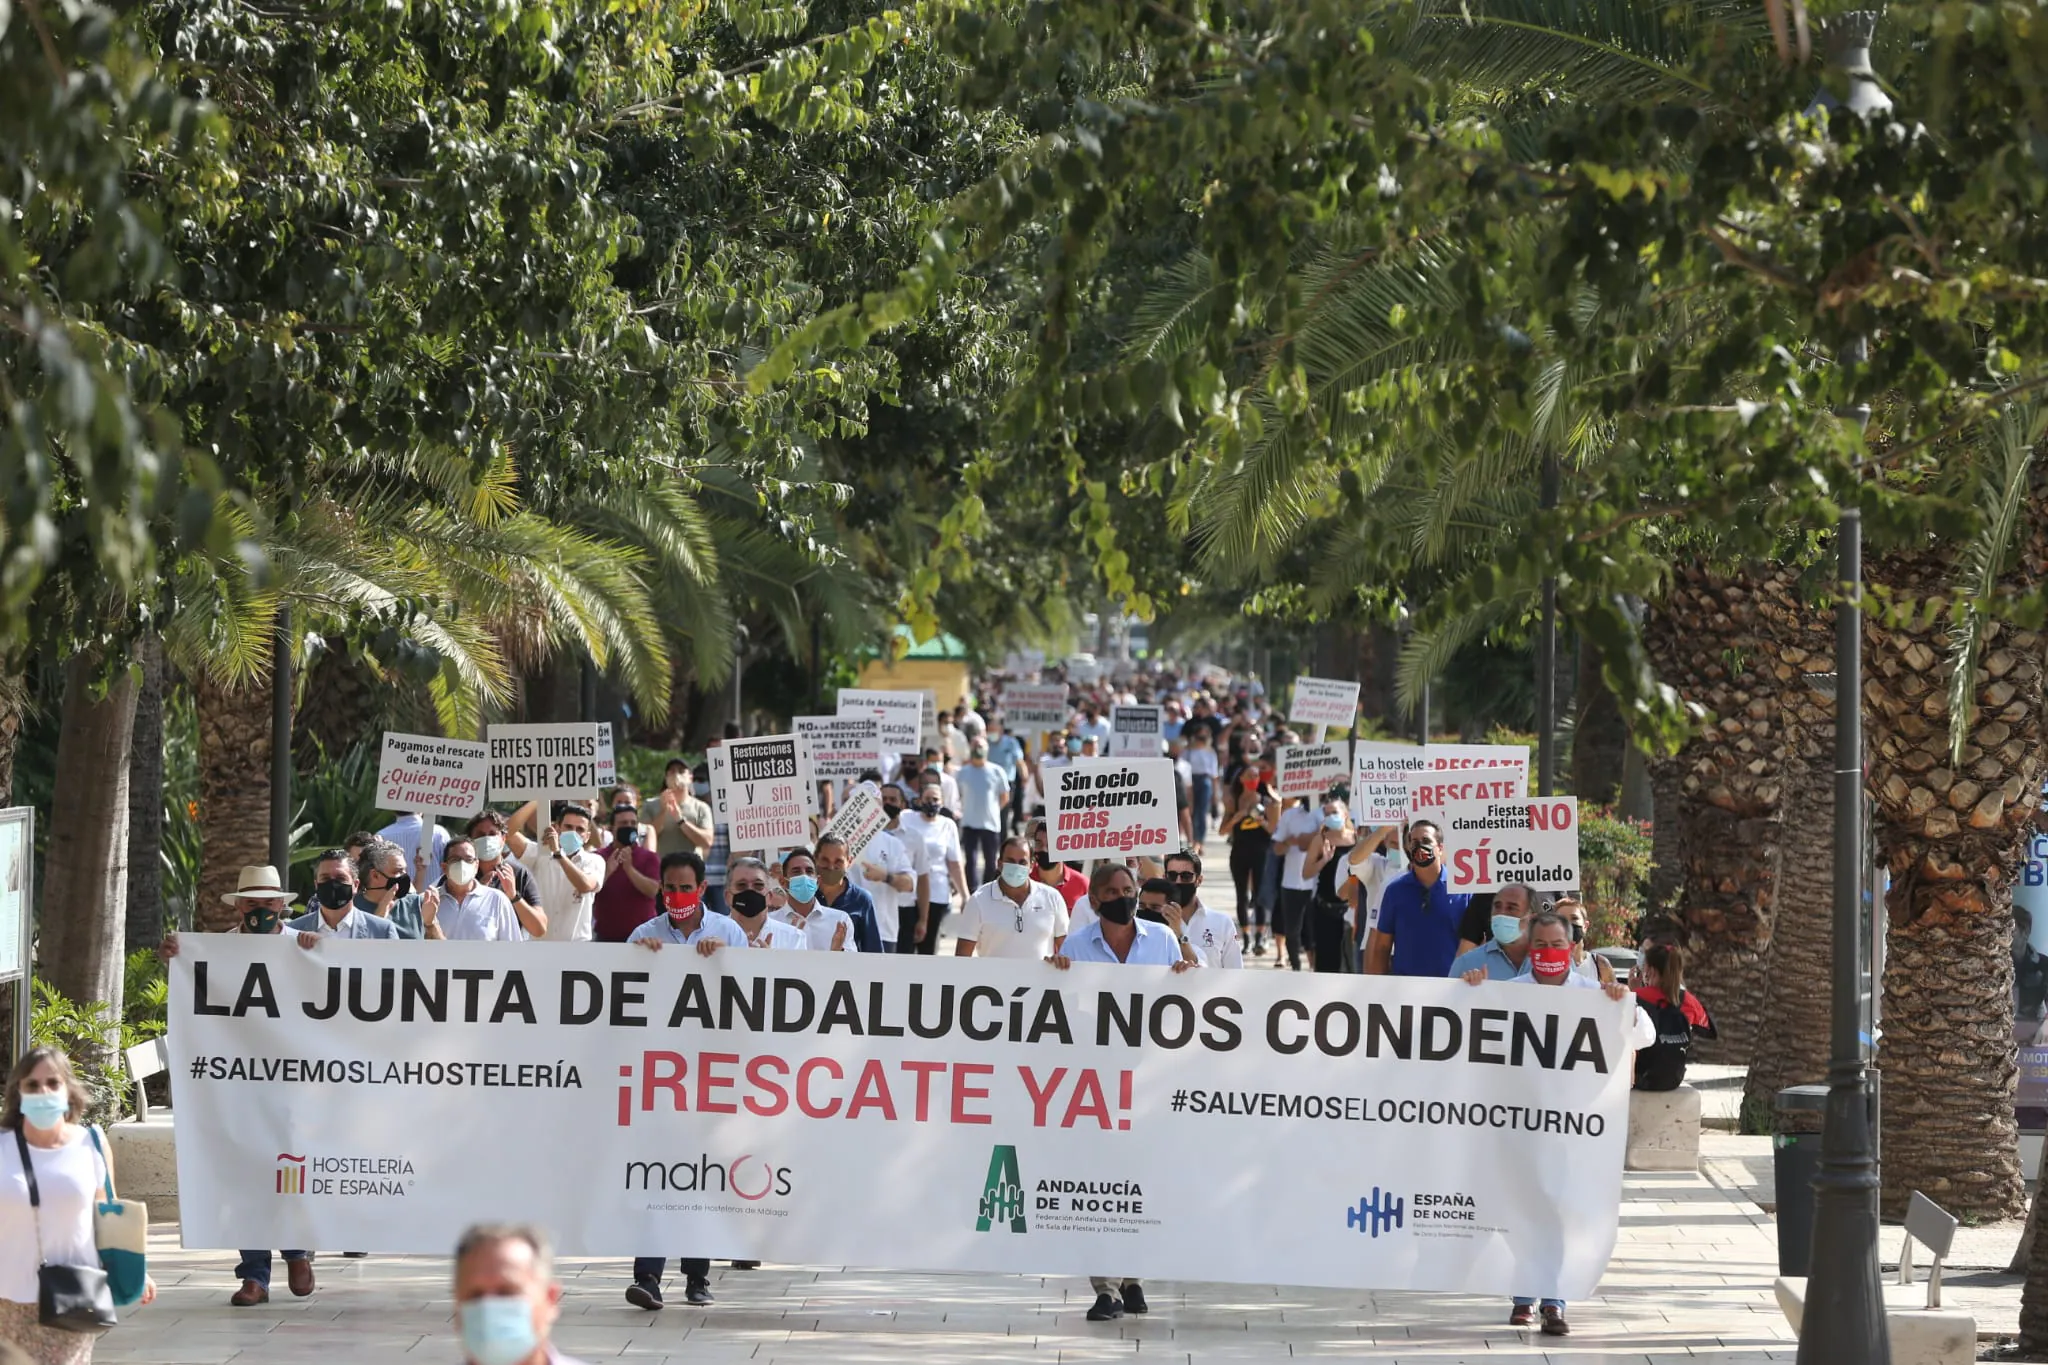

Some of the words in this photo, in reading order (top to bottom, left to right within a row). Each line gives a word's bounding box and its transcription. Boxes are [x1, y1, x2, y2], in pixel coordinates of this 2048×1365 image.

[842, 698, 864, 707] Junta
[866, 698, 875, 706] de
[798, 722, 813, 731] NO
[388, 738, 434, 753] Pagamos
[436, 742, 445, 755] el
[446, 745, 485, 759] rescate
[491, 737, 532, 759] ERTES
[536, 736, 594, 758] TOTALES
[733, 743, 792, 758] Restricciones
[832, 740, 861, 749] ERTE
[883, 736, 915, 746] ayudas
[406, 753, 418, 765] de
[421, 754, 430, 766] la
[432, 756, 463, 770] banca
[1286, 748, 1303, 760] Sin
[1305, 746, 1331, 757] ocio
[734, 758, 794, 780] injustas
[1284, 756, 1341, 770] nocturno,
[1360, 757, 1374, 770] La
[1378, 756, 1424, 770] hostele
[382, 767, 437, 786] ¿Quién
[440, 776, 481, 794] paga
[491, 763, 548, 789] HASTA
[554, 762, 596, 788] 2021
[1061, 770, 1091, 791] Sin
[1095, 767, 1139, 789] ocio
[1360, 771, 1374, 779] NO
[1389, 770, 1398, 779] el
[387, 787, 401, 801] el
[405, 790, 474, 809] nuestro?
[745, 783, 754, 805] y
[772, 783, 793, 802] sin
[1369, 784, 1381, 795] La
[1411, 780, 1516, 813] ¡RESCATE
[1059, 790, 1158, 810] nocturno,
[1373, 797, 1386, 806] es
[735, 802, 801, 822] justificación
[1058, 805, 1110, 831] más
[1370, 806, 1381, 819] la
[1488, 804, 1531, 818] Fiestas
[1529, 803, 1571, 831] NO
[736, 818, 803, 840] científica
[1452, 817, 1531, 830] clandestinas
[1056, 823, 1168, 851] contagios
[1453, 837, 1492, 886] SÍ
[1496, 848, 1534, 865] Ocio
[1496, 865, 1573, 884] regulado
[193, 960, 281, 1019] LA
[301, 966, 538, 1026] JUNTA
[559, 969, 650, 1027] DE
[1096, 991, 1243, 1052] NOS
[1266, 999, 1609, 1075] CONDENA
[190, 1055, 583, 1089] #SALVEMOSLAHOSTELERÍA
[617, 1050, 994, 1127] ¡RESCATE
[1017, 1064, 1133, 1131] YA!
[1171, 1088, 1605, 1138] #SALVEMOSELOCIONOCTURNO
[313, 1155, 415, 1175] HOSTELERÍA
[312, 1178, 334, 1195] DE
[340, 1177, 405, 1196] ESPAÑA
[1036, 1179, 1143, 1197] ANDALUCÍA
[1036, 1197, 1060, 1211] DE
[1071, 1199, 1143, 1214] NOCHE
[1414, 1192, 1476, 1208] ESPAÑA
[646, 1203, 690, 1212] Asociación
[691, 1203, 702, 1211] de
[745, 1206, 756, 1214] de
[757, 1207, 788, 1217] Málaga
[1413, 1209, 1430, 1219] DE
[1433, 1209, 1476, 1221] NOCHE
